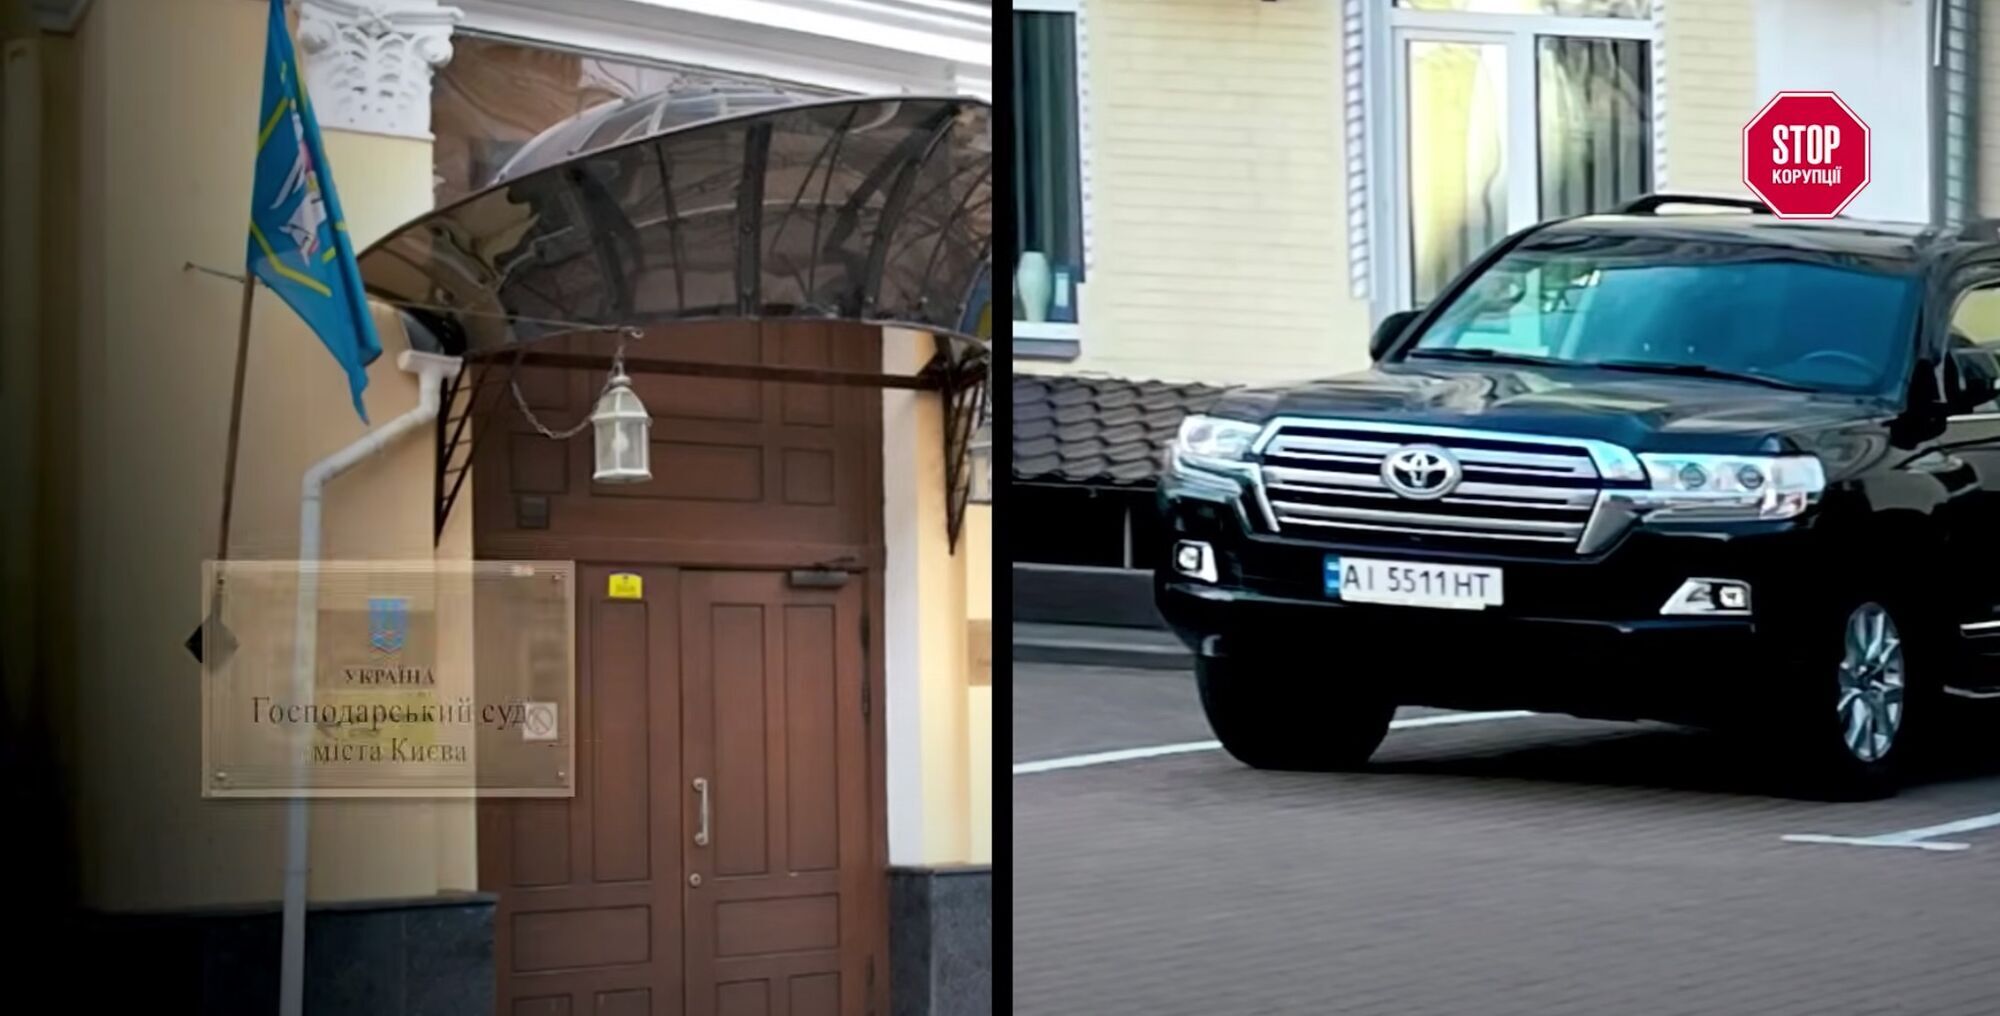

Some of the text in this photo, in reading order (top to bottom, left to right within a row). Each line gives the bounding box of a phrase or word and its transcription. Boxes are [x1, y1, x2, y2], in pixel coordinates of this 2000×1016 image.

[1343, 564, 1490, 597] AI 5511 HT
[345, 667, 435, 685] УКРАЇНА
[251, 696, 528, 730] Господарський суд
[313, 738, 467, 763] міста Києва
